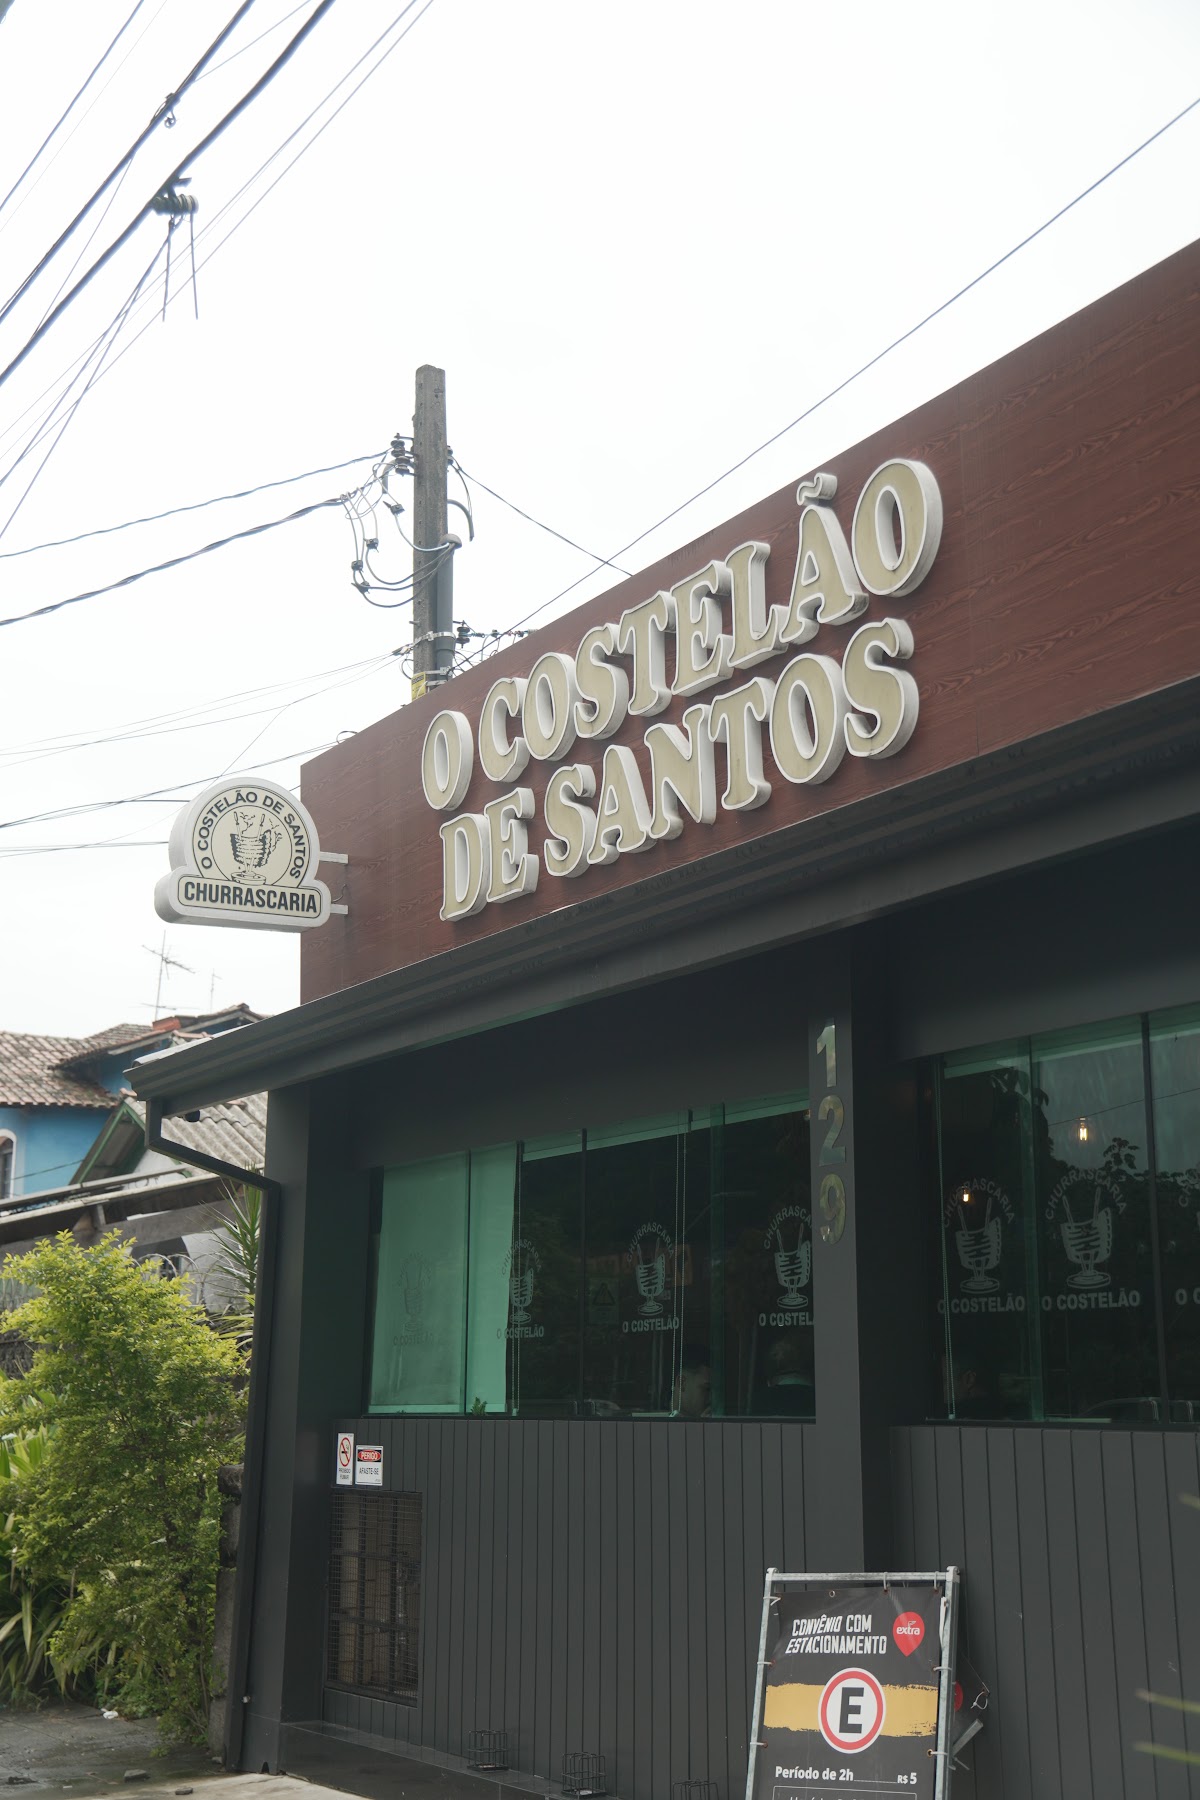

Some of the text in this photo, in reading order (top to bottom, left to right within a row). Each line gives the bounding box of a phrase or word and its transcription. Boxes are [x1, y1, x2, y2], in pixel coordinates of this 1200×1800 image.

[421, 458, 943, 811] O COSTELÃO
[439, 618, 919, 922] DE SANTOS
[197, 789, 307, 880] O COSTELÃO DE SANTOS
[184, 881, 318, 913] CHURRASCARIA
[1045, 1168, 1127, 1220] CHURRASCARIA
[763, 1205, 813, 1250] CHURRASCA
[627, 1222, 675, 1263] CHURRASCARIA
[951, 1292, 1026, 1313] COSTELÃO
[1041, 1288, 1141, 1311] O COSTELÃO
[622, 1315, 680, 1333] O COSTELÃO
[758, 1312, 814, 1327] O COSTEL
[791, 1614, 873, 1637] CONVÊNIO COM
[896, 1621, 921, 1636] extra
[785, 1635, 887, 1655] ESTACIONAMENTO
[838, 1686, 865, 1734] E
[775, 1766, 917, 1785] Período de 2h R$ 5
